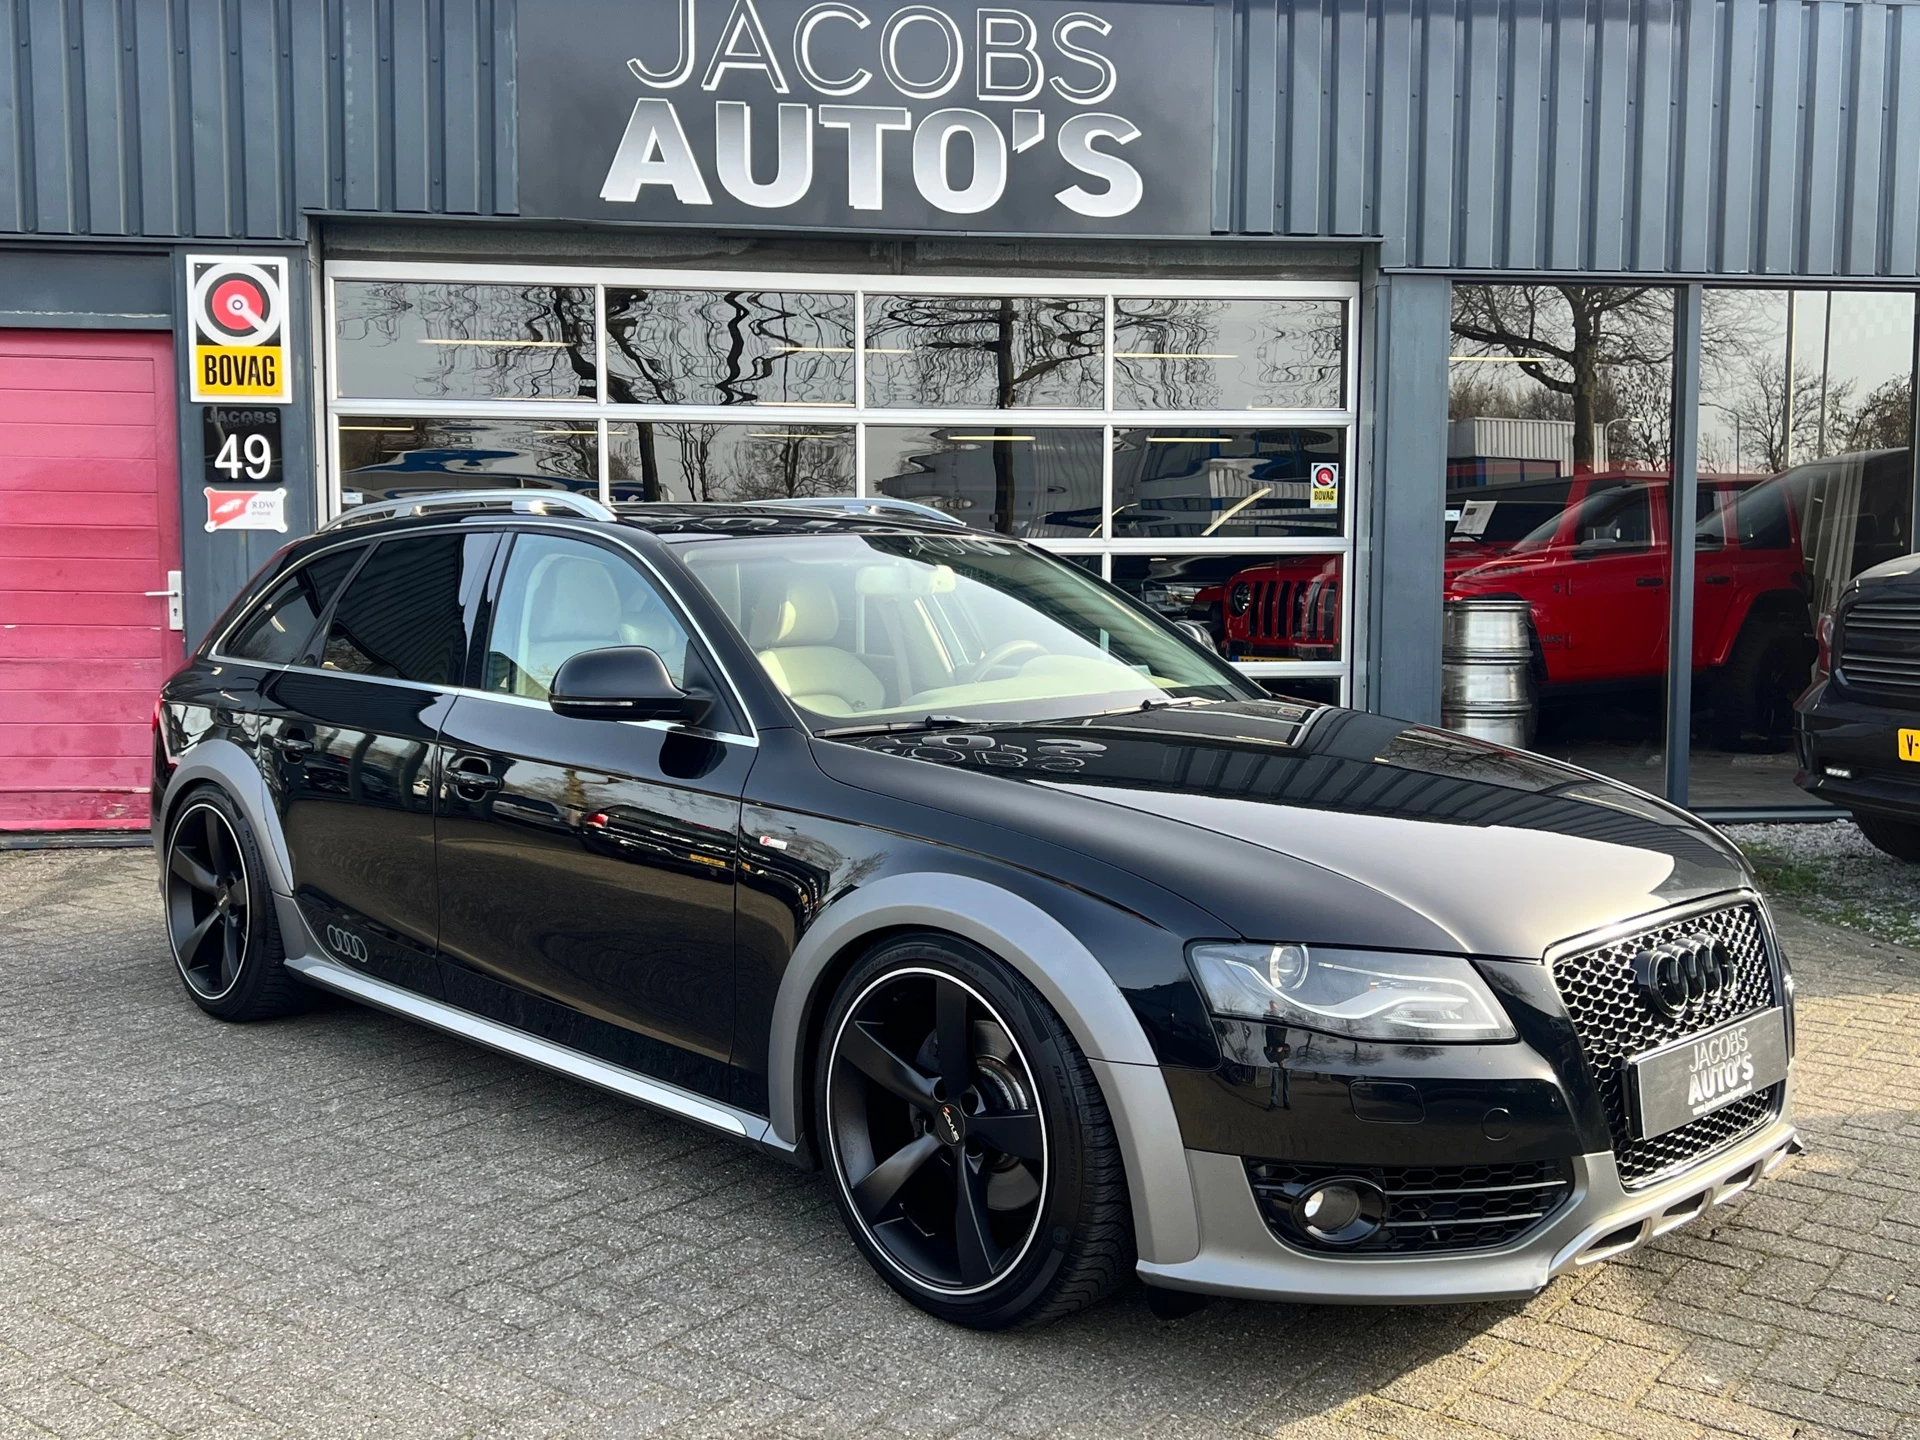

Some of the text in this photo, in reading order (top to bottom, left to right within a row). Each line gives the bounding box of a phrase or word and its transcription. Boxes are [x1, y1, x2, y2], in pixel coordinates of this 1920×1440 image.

[626, 0, 1117, 105] JACOBS
[600, 97, 1143, 217] AUTO'S
[204, 355, 276, 386] BOVAG
[205, 411, 277, 424] JACOBS
[215, 434, 271, 479] 49
[251, 501, 276, 509] RDW
[1314, 491, 1334, 501] BOVAG
[1689, 1026, 1748, 1072] JACOBS
[1688, 1052, 1754, 1106] AUTO'S
